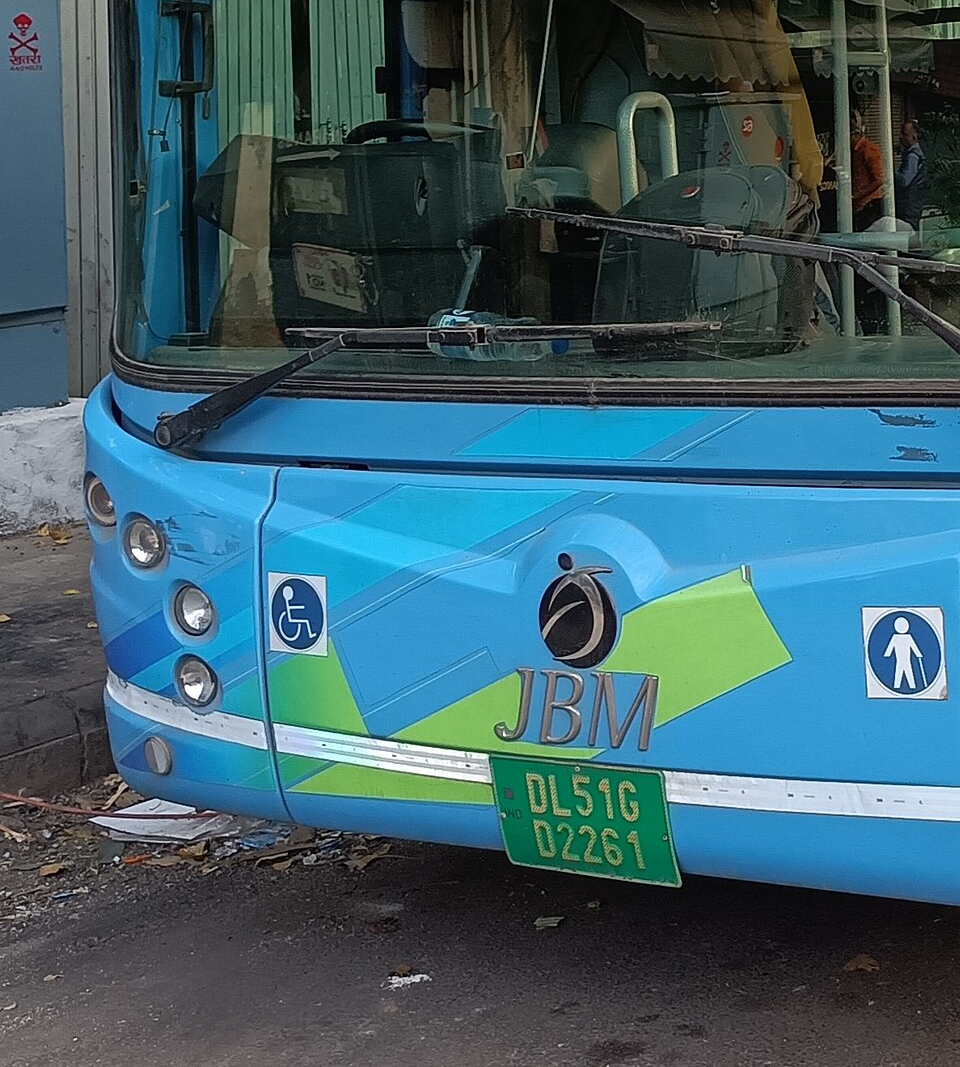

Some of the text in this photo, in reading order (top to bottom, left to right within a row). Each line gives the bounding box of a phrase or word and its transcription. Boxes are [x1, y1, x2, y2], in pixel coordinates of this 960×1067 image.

[493, 667, 659, 751] JBM
[525, 772, 639, 823] DL51G
[532, 818, 646, 870] D2261
